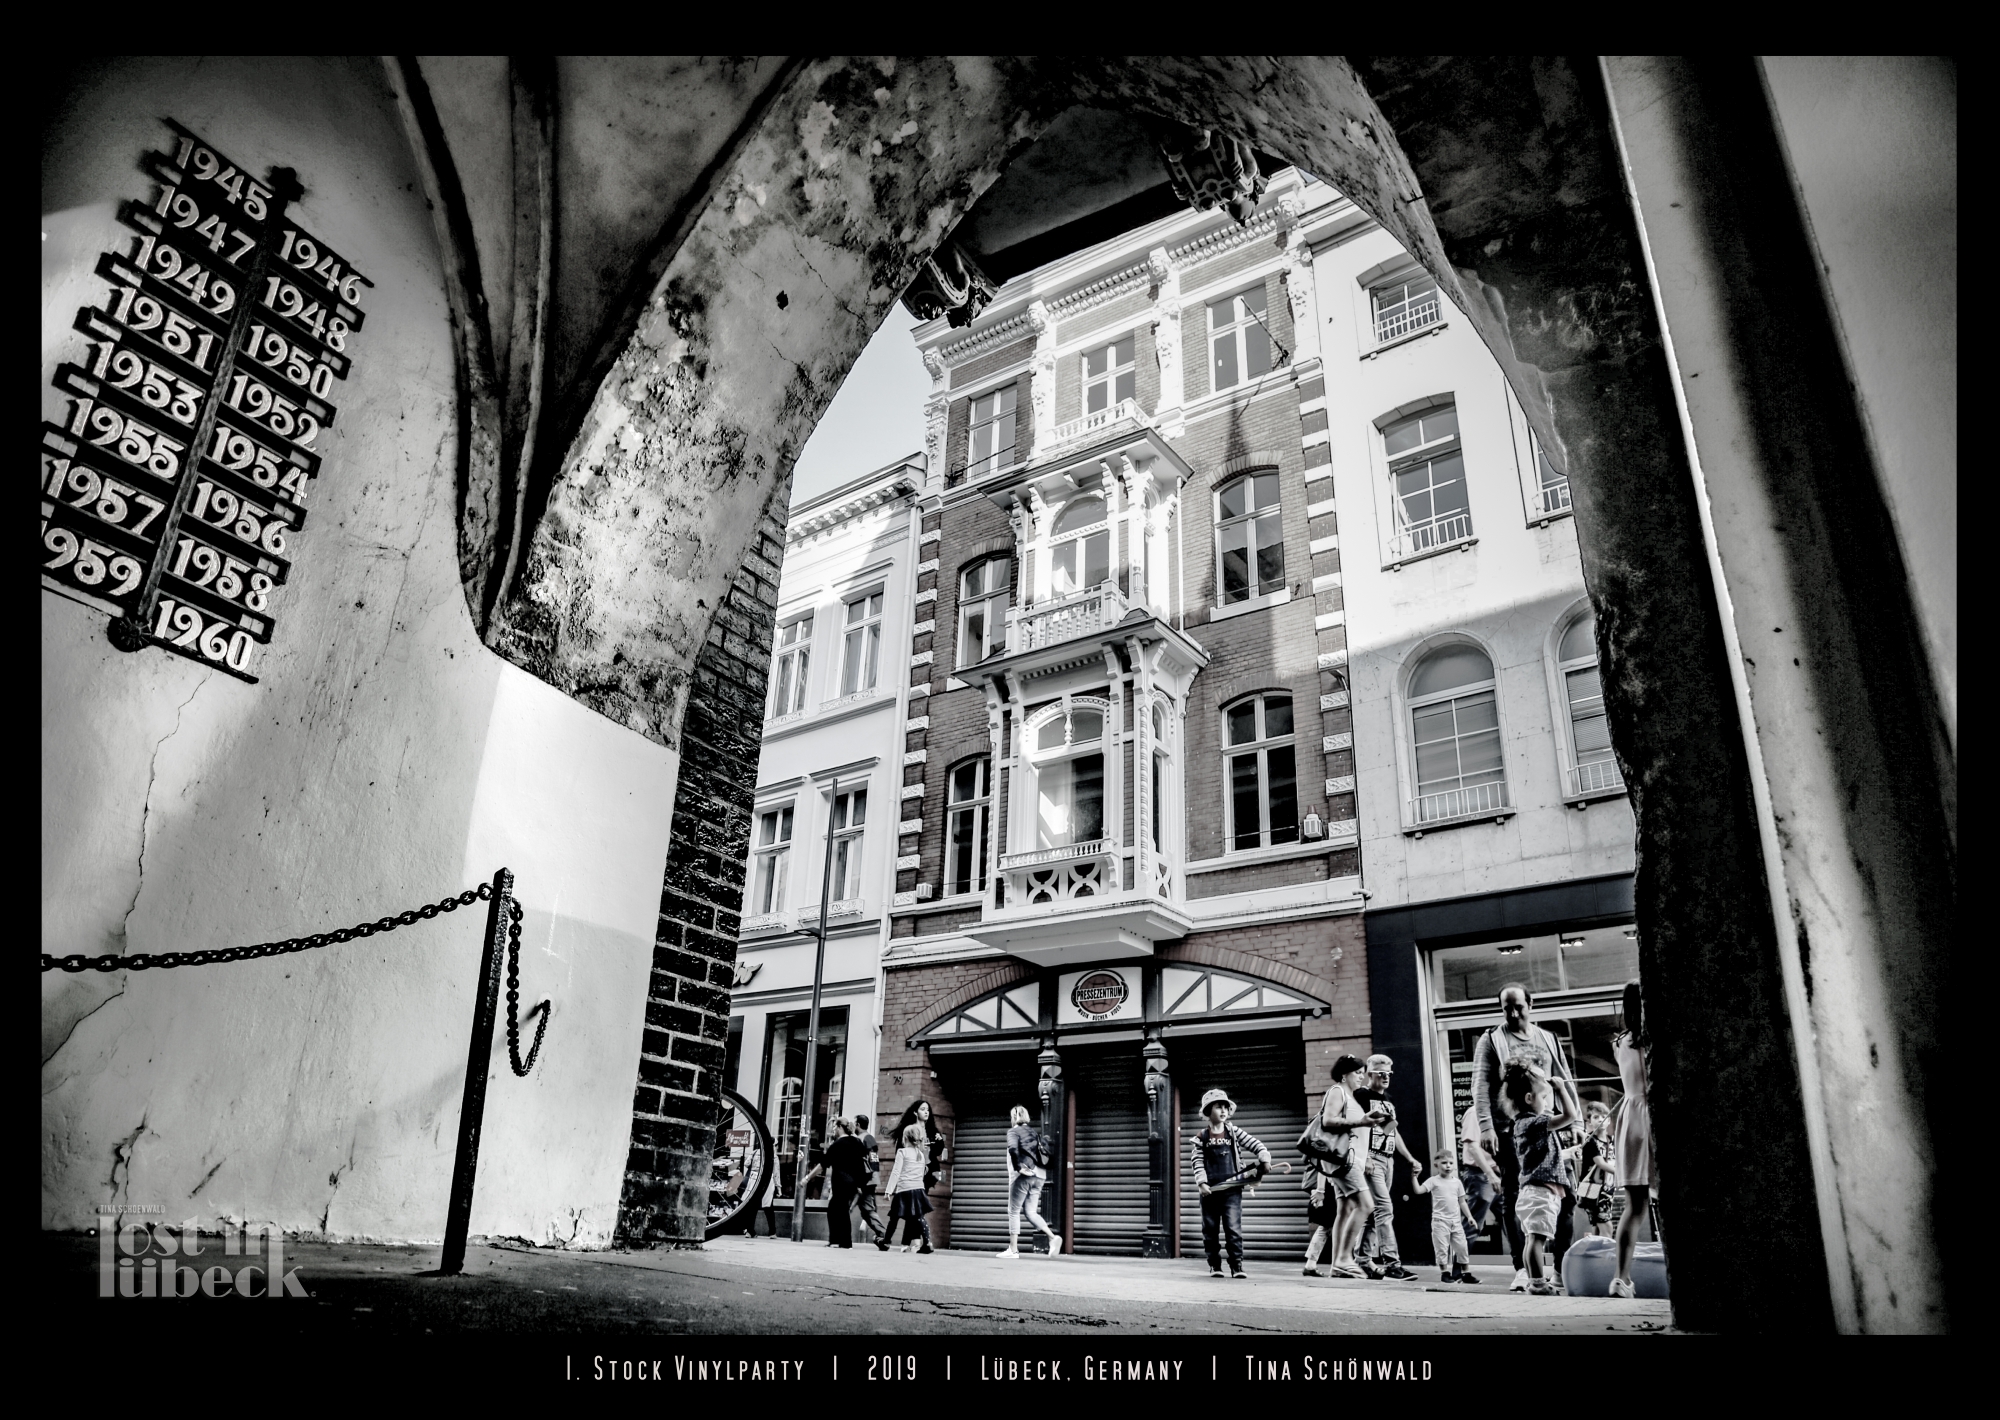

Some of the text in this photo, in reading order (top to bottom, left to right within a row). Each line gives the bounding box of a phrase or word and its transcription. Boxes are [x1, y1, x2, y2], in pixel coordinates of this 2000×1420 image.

[174, 136, 274, 222] 1945
[155, 184, 256, 268] 1947
[135, 235, 237, 317] 1949
[279, 230, 363, 306] 1946
[113, 286, 216, 369] 1951
[264, 276, 350, 353] 1948
[92, 340, 205, 427] 1953
[248, 325, 335, 400] 1950
[68, 398, 185, 481] 1955
[230, 374, 319, 453] 1952
[46, 458, 166, 537] 1957
[212, 425, 308, 507] 1954
[194, 481, 287, 557] 1956
[41, 520, 143, 597] 959
[174, 538, 273, 612] 1958
[154, 600, 254, 672] 1960
[1076, 986, 1123, 1001] PRESSEZENTRUM
[893, 1075, 903, 1085] 79
